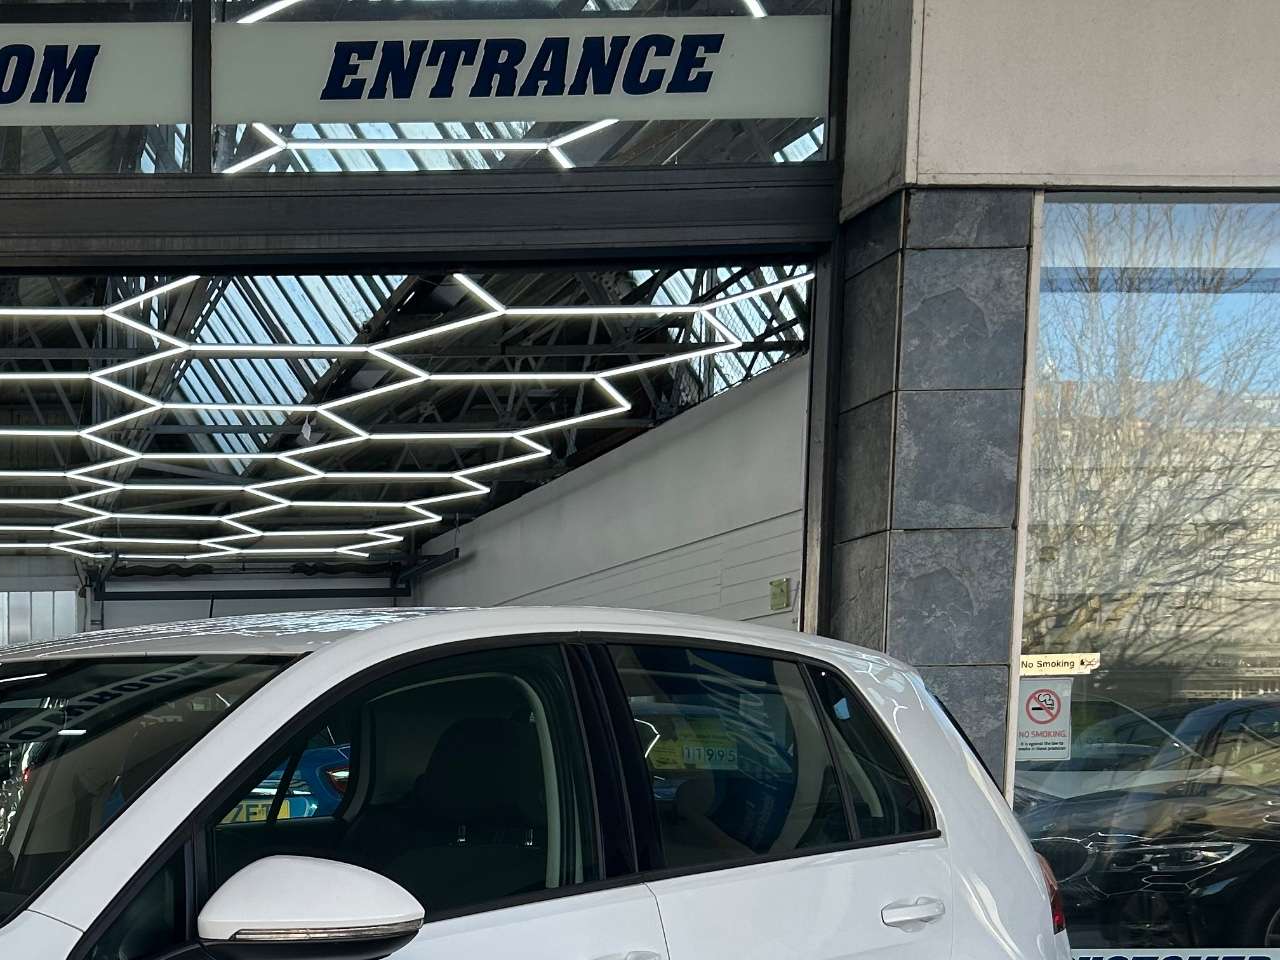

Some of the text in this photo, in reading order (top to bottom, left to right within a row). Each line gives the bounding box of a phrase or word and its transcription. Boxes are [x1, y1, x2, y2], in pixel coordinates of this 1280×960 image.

[320, 33, 725, 101] ENTRANCE
[1021, 659, 1075, 669] No Smoking
